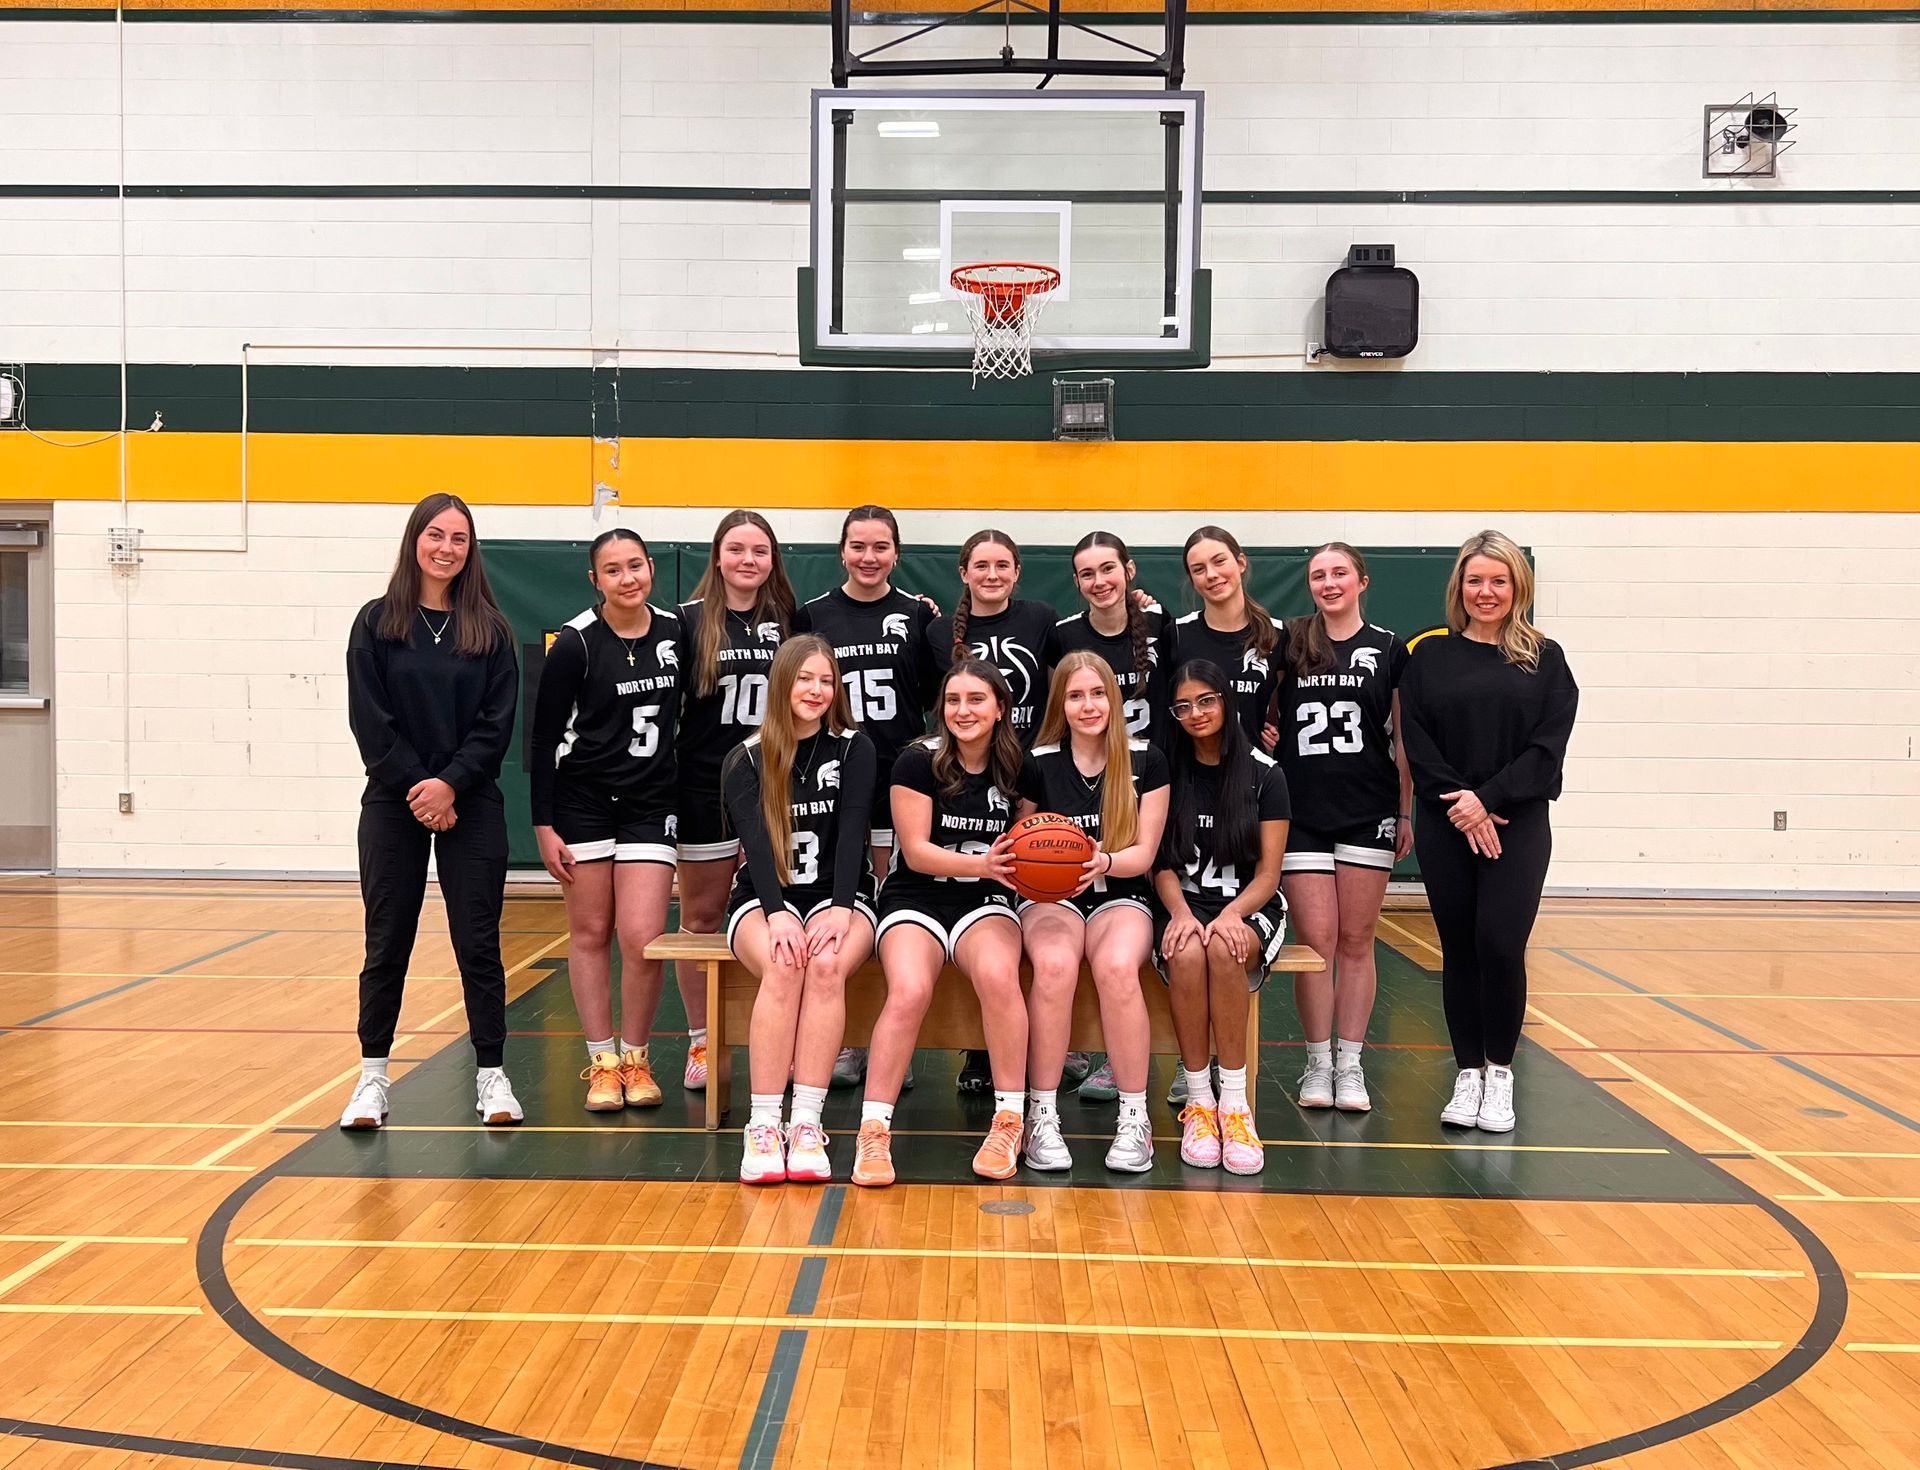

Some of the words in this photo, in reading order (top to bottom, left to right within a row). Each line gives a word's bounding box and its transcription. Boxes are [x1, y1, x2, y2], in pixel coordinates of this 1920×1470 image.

[716, 649, 752, 661] ORTH
[753, 648, 774, 661] BAY
[833, 644, 874, 659] NORTH
[875, 643, 899, 655] BAY
[616, 678, 654, 695] NORTH
[655, 675, 675, 689] BAY
[1237, 680, 1260, 693] BAY
[1297, 674, 1336, 688] NORTH
[1339, 674, 1364, 688] BAY
[718, 674, 769, 726] 10
[841, 668, 897, 722] 15
[1011, 706, 1034, 724] BAY
[1123, 698, 1150, 737] 2
[628, 704, 660, 757] 5
[1296, 701, 1364, 756] 23
[810, 799, 835, 815] BAY
[941, 814, 983, 831] NORTH
[985, 819, 1006, 833] BAY
[1028, 839, 1084, 852] EVOLUTION
[788, 830, 819, 885] 3
